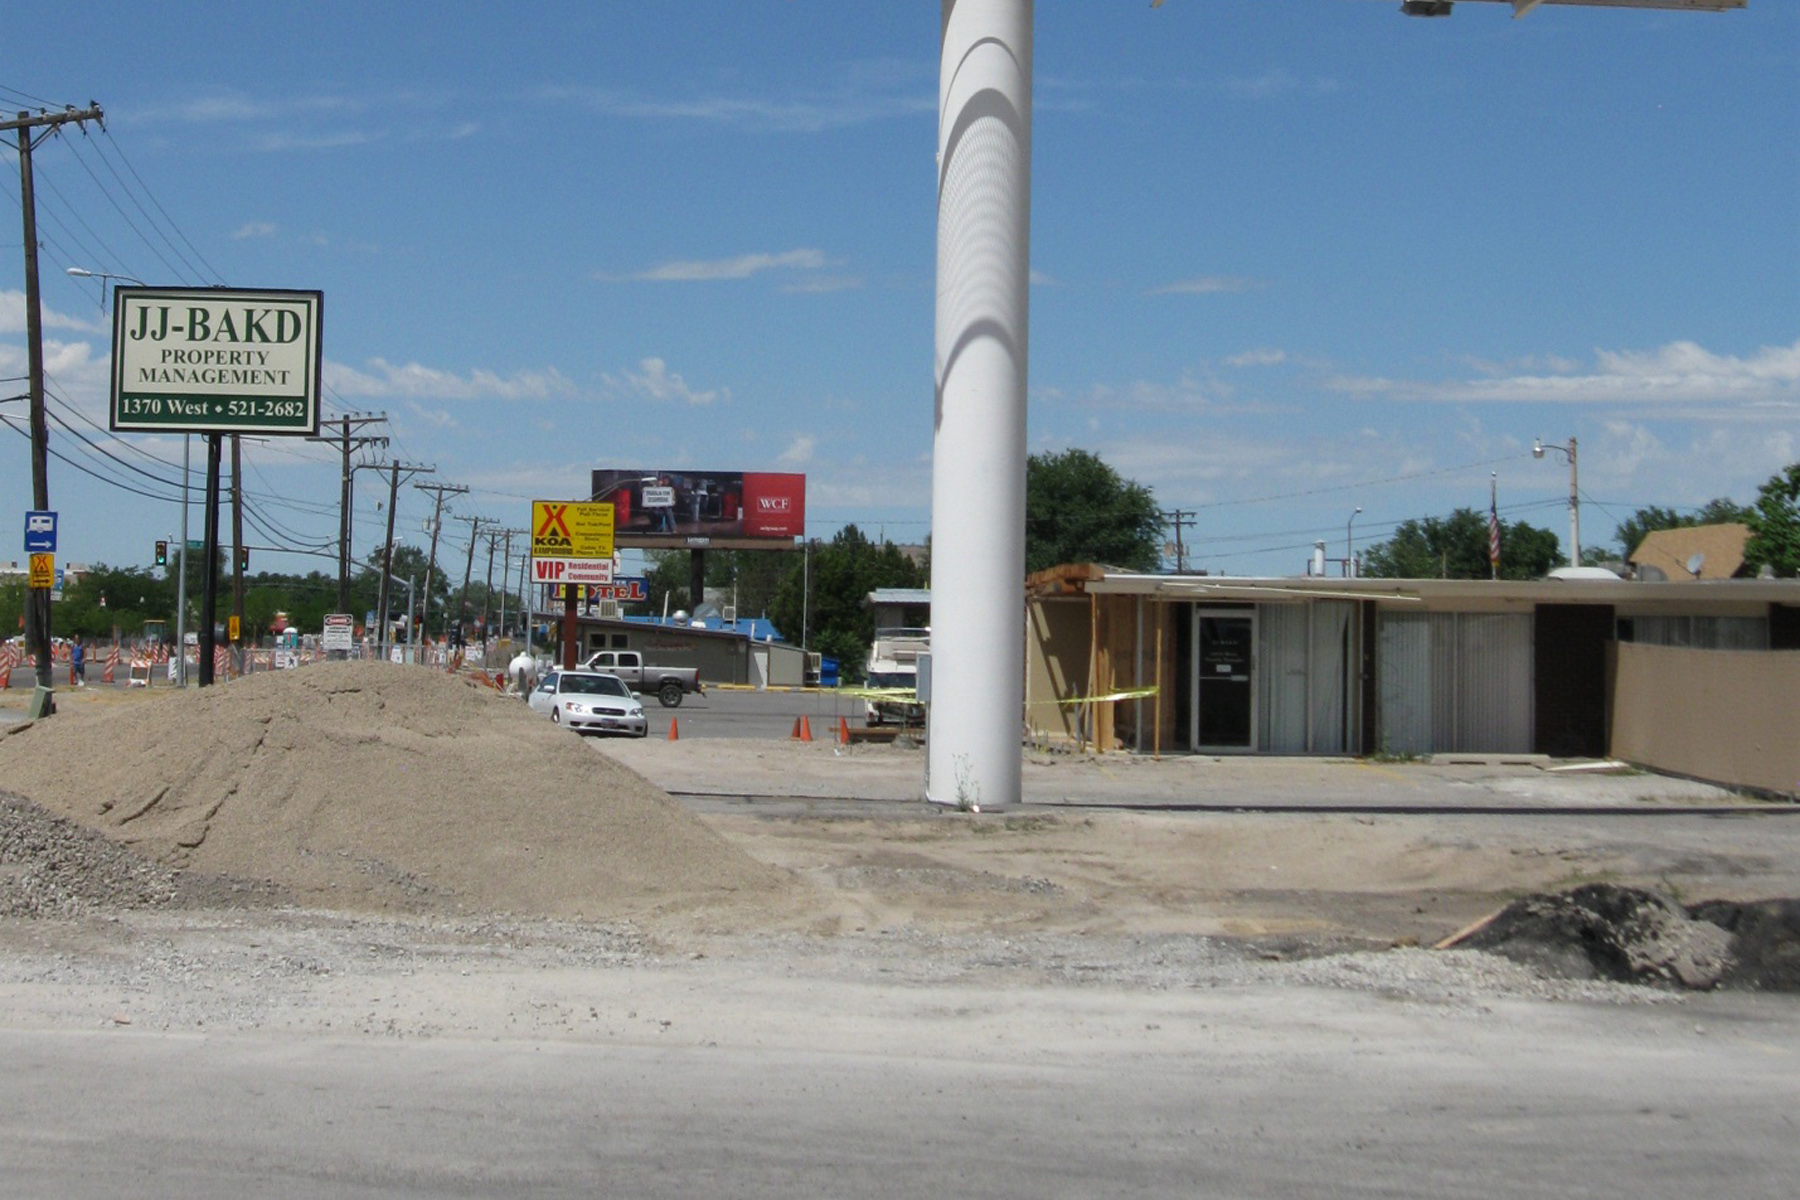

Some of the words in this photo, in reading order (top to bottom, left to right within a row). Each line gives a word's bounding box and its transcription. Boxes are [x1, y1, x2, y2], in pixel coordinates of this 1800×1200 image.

[130, 307, 301, 343] JJ-BAKD
[161, 349, 270, 365] PROPERTY
[139, 368, 290, 385] MANAGEMENT
[123, 399, 161, 415] 1370
[167, 400, 208, 415] West
[228, 401, 304, 416] 521-2682
[760, 498, 788, 509] WCF
[535, 537, 572, 546] KOA
[536, 561, 565, 579] VIP
[568, 562, 609, 570] Residential
[568, 572, 609, 581] Community
